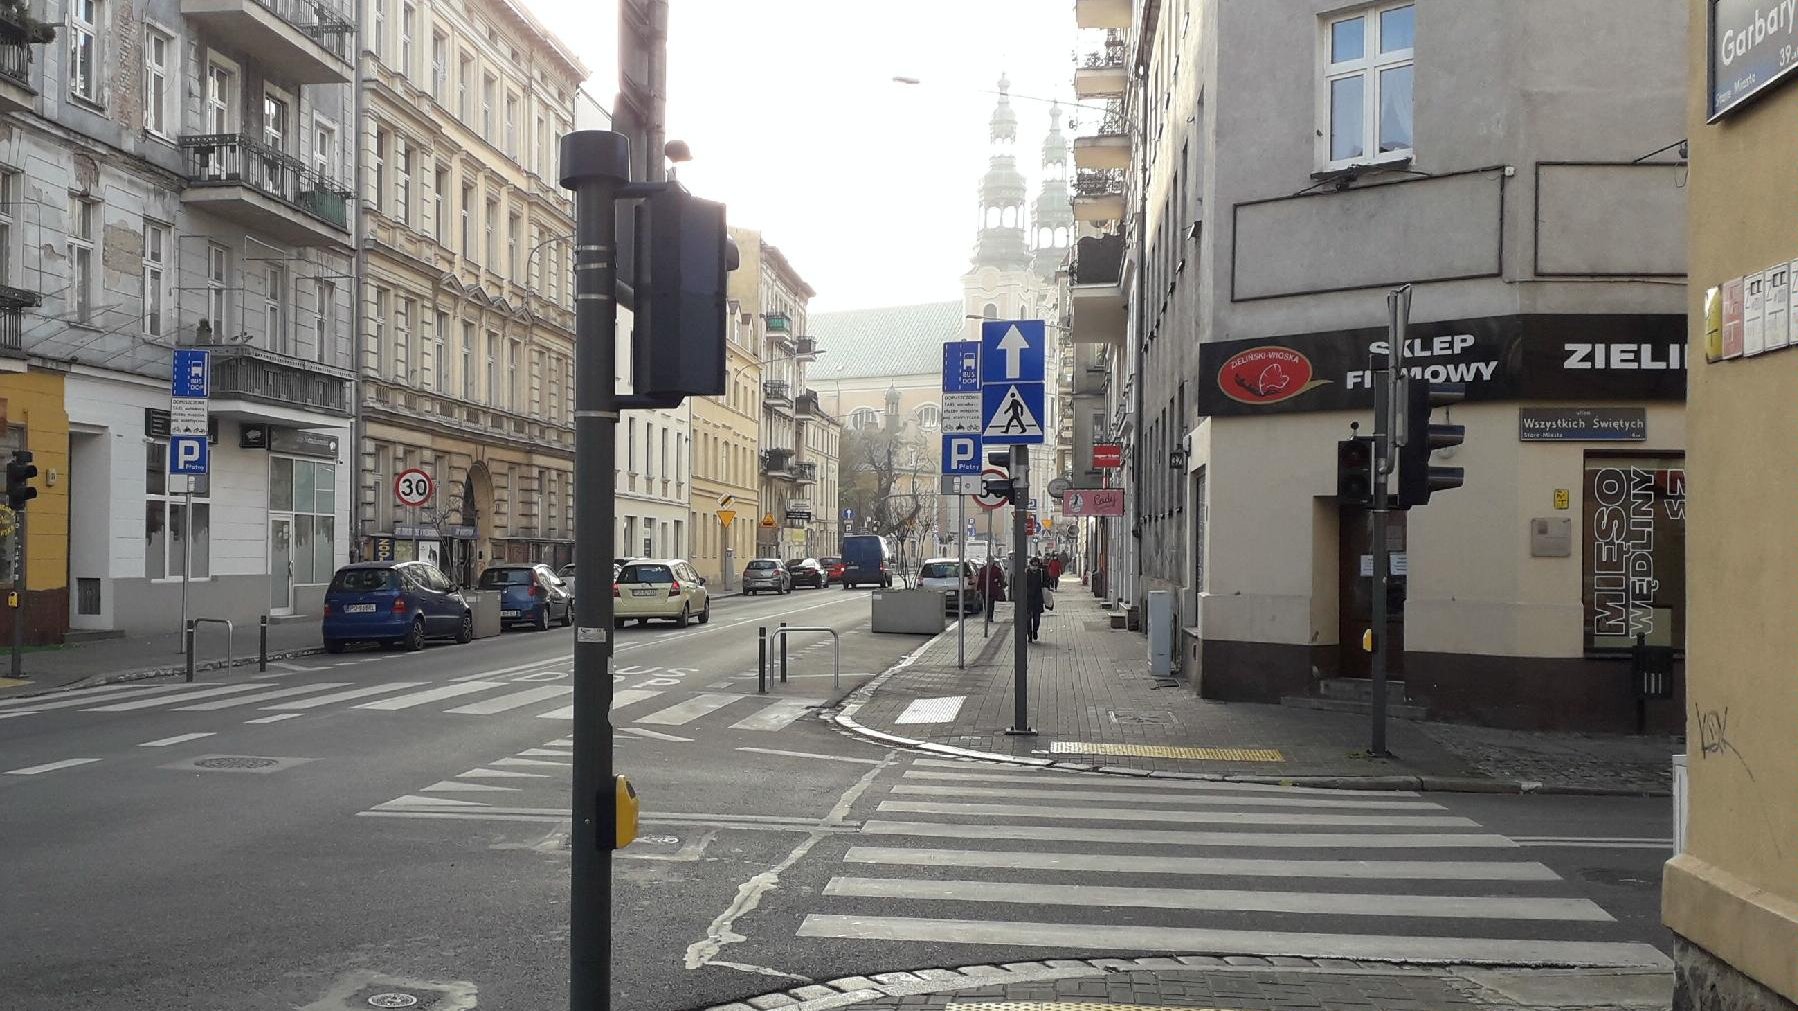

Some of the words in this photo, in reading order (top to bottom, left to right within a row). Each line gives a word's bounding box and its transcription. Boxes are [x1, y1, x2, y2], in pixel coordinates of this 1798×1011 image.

[1721, 0, 1796, 66] Garbary
[1563, 343, 1688, 369] ZIELI
[1523, 418, 1585, 432] Wszystkich
[1592, 415, 1644, 432] Świętych
[951, 438, 974, 470] P
[401, 478, 427, 497] 30
[1594, 467, 1631, 635] MIĘSO
[1629, 465, 1659, 639] WĘDLINY
